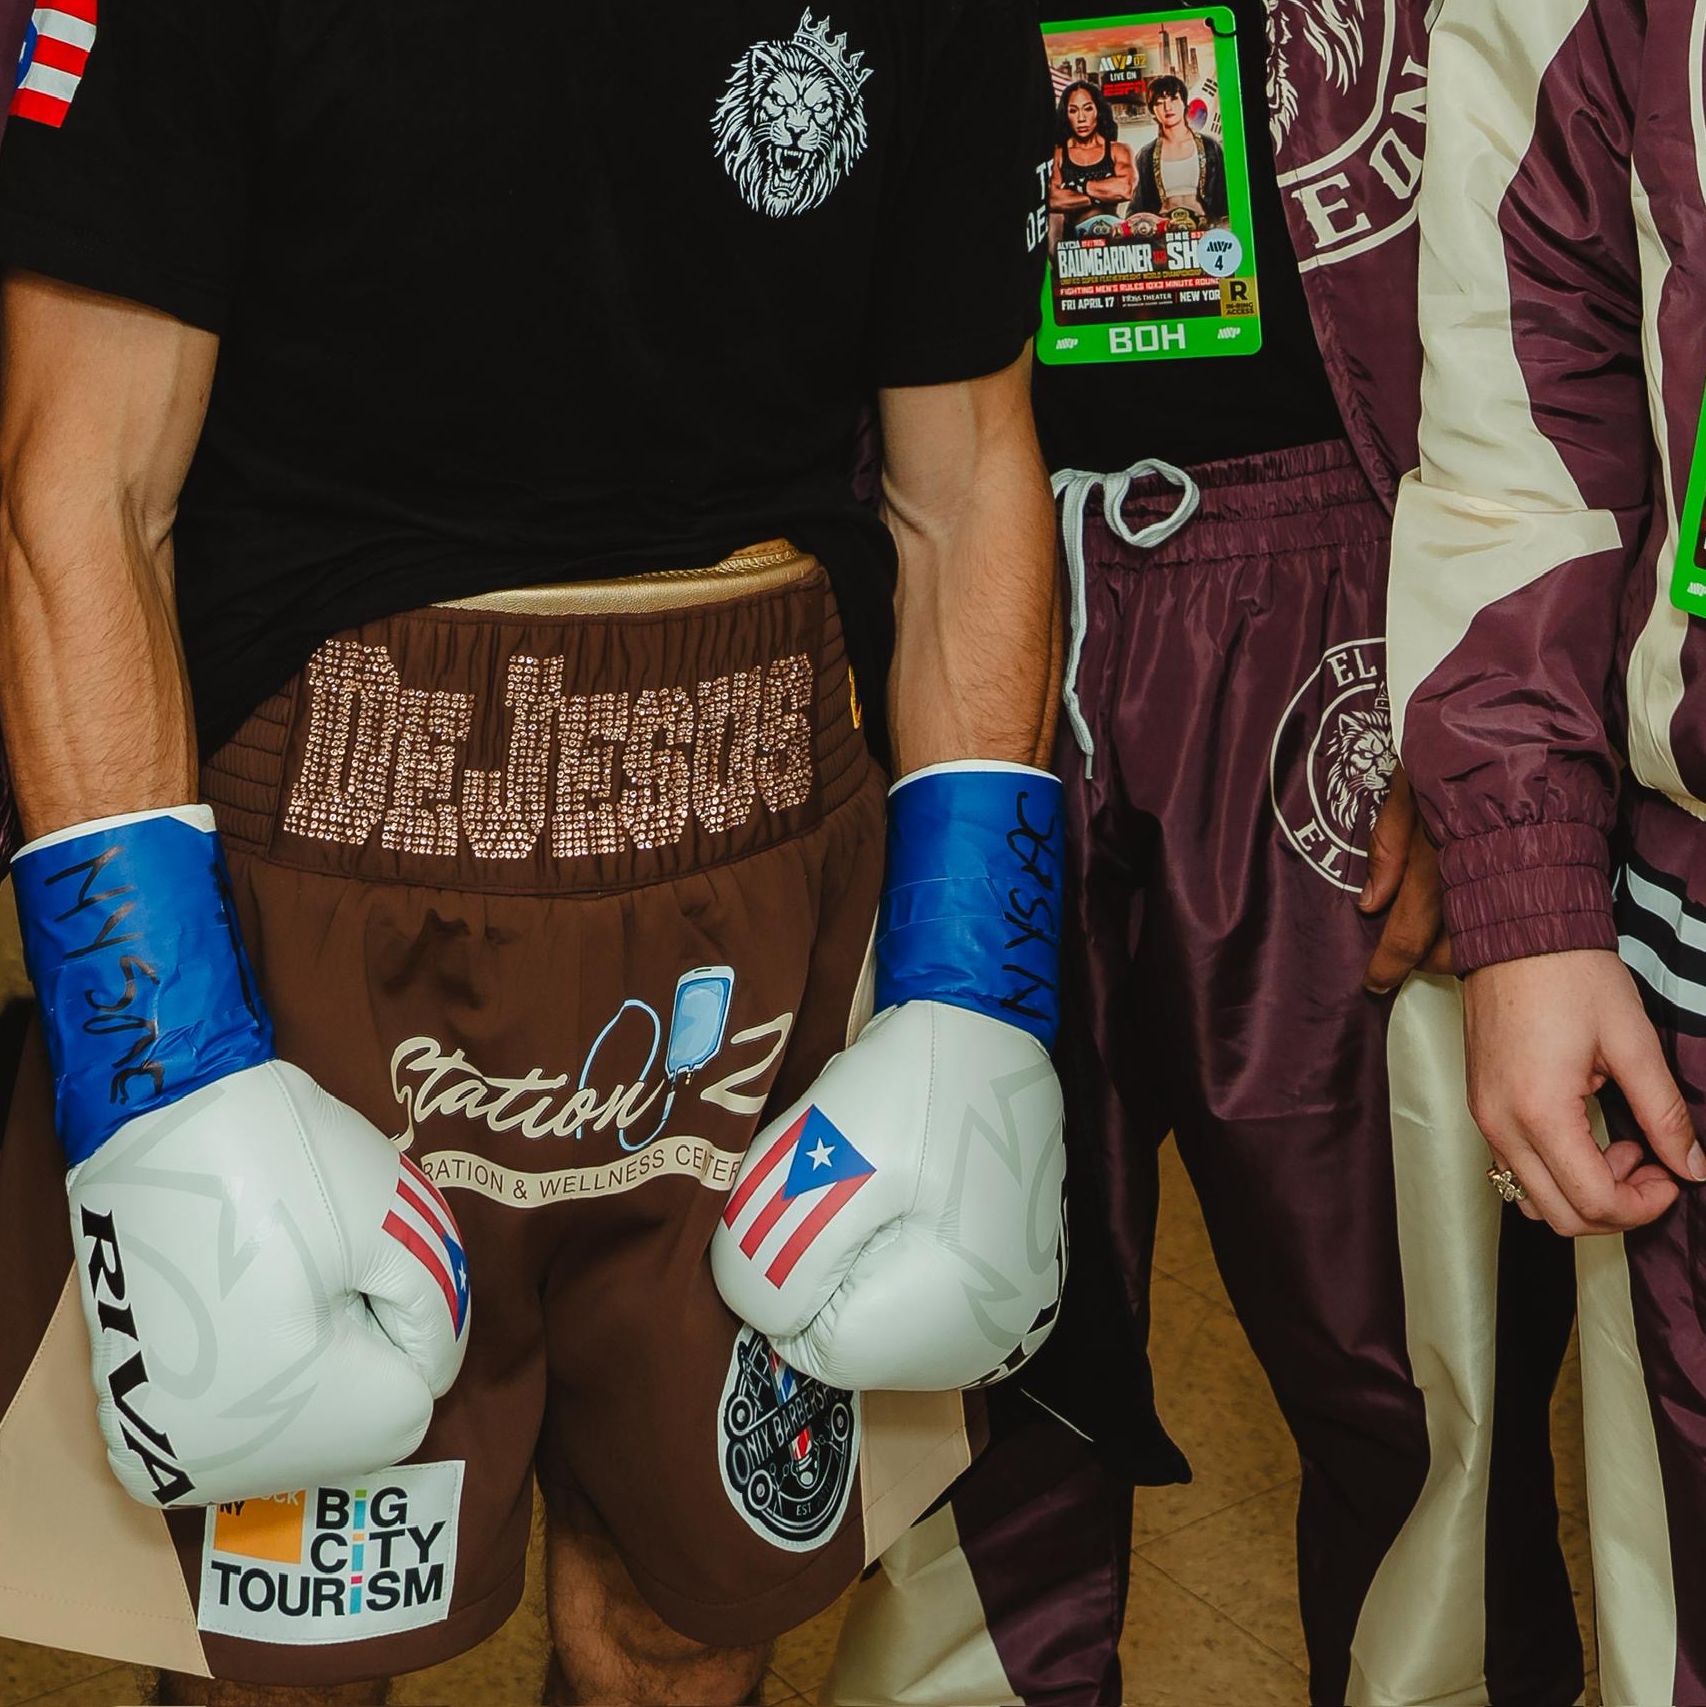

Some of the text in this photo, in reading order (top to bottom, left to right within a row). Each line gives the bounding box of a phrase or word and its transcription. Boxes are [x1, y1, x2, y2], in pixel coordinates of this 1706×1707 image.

[1099, 54, 1146, 71] MVP 02
[1110, 71, 1137, 82] LIVE ON
[1103, 81, 1147, 97] ESPN
[1057, 243, 1153, 279] BAUMGARDNER
[1166, 239, 1200, 270] SH
[1214, 254, 1224, 271] 4
[1060, 286, 1094, 295] FIGHTING
[1095, 284, 1119, 293] MEN'S
[1119, 282, 1144, 292] RULES
[1165, 278, 1194, 288] MINUTE
[1194, 277, 1221, 286] ROUND
[1229, 280, 1249, 302] R
[1061, 299, 1076, 311] FRI
[1078, 297, 1104, 309] APRIL
[1105, 296, 1114, 308] 17
[1142, 292, 1172, 302] THEATER
[1179, 289, 1221, 302] NEW YOR
[1225, 307, 1255, 316] ACCESS
[1109, 323, 1187, 354] BOH
[390, 1035, 665, 1152] Station
[423, 1144, 743, 1201] RATION & WELLNESS CETER
[81, 1202, 196, 1508] RIVA
[796, 1504, 812, 1517] EST
